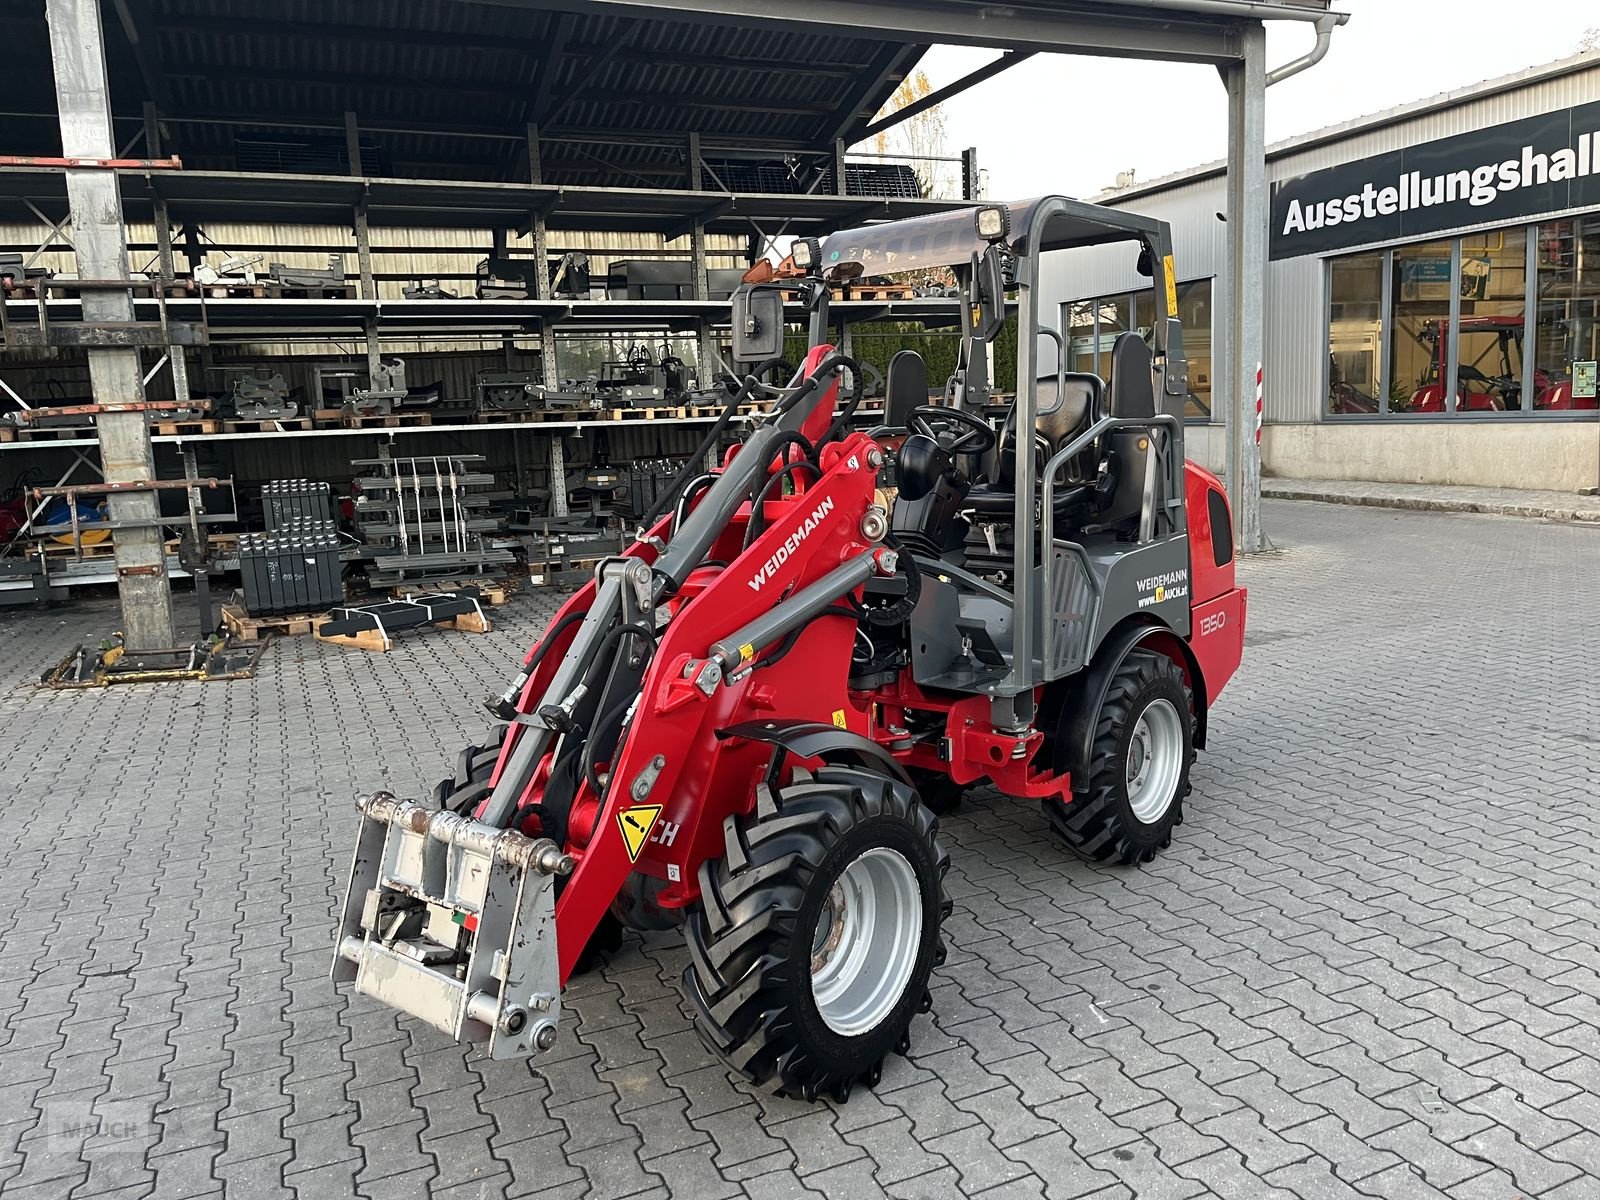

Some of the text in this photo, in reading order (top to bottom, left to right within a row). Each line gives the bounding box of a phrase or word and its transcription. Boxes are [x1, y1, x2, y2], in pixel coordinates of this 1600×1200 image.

[748, 496, 834, 592] WEIDEMANN
[1136, 568, 1187, 593] WEIDEMANN
[1200, 611, 1225, 637] 1350
